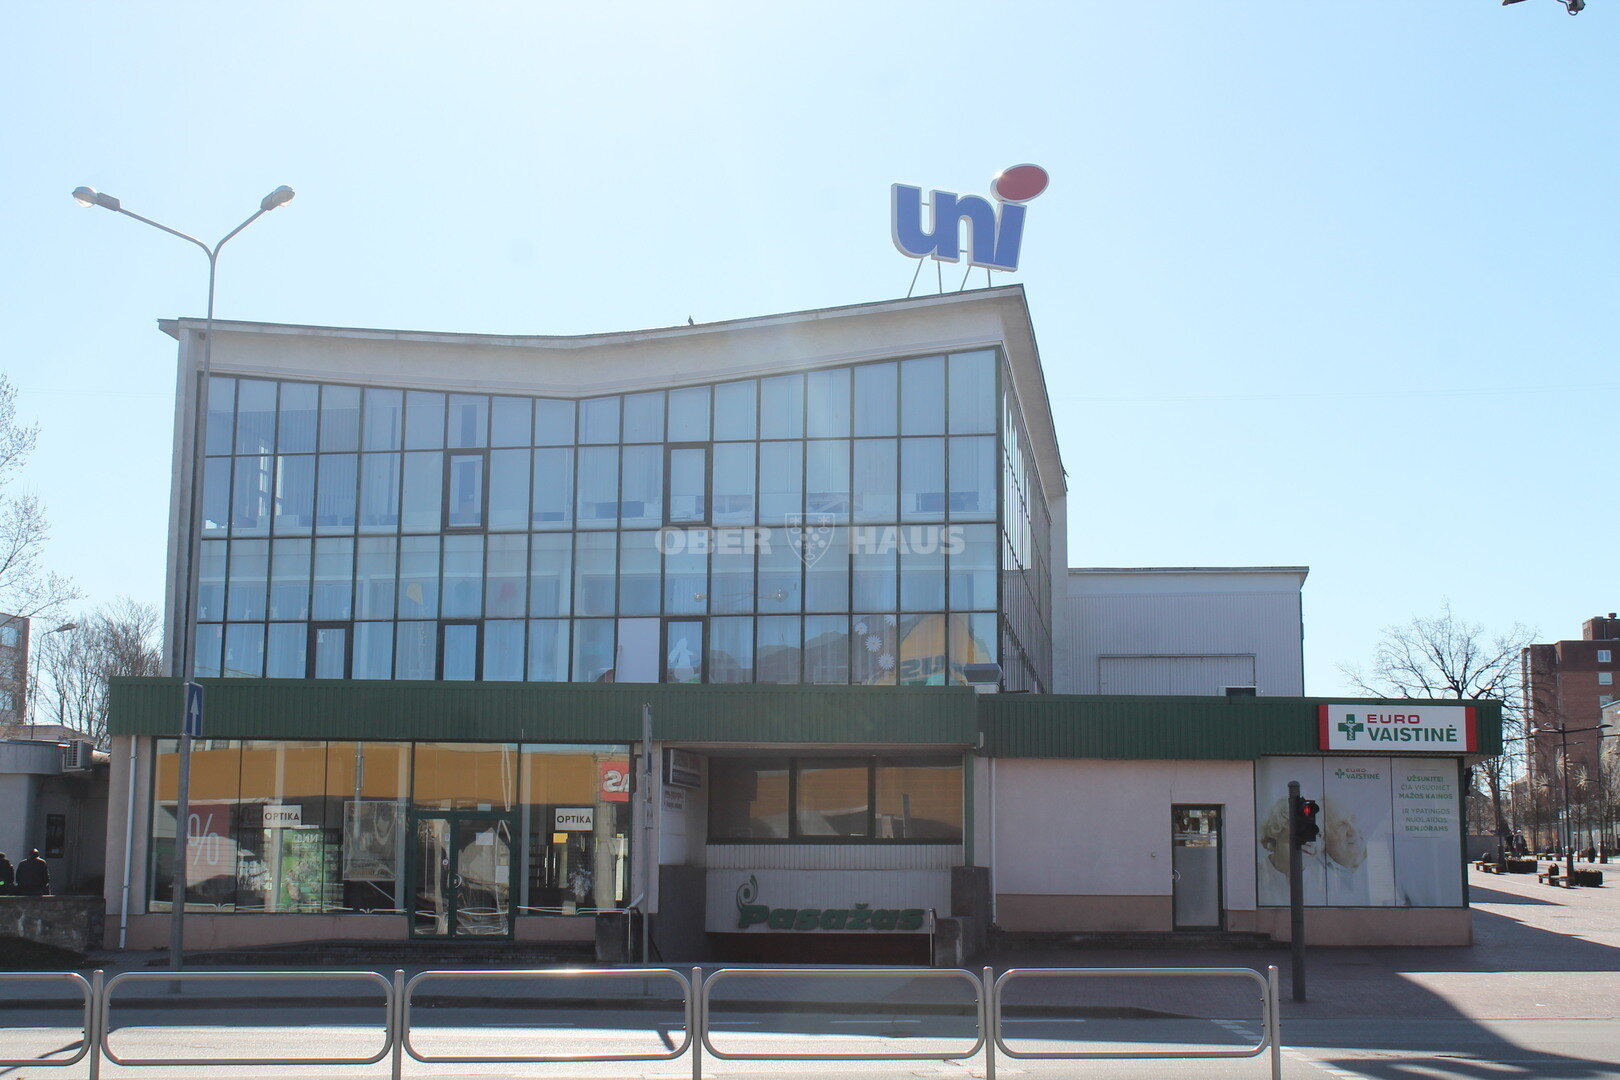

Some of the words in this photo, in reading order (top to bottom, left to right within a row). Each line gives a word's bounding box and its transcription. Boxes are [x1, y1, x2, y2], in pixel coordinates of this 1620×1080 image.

[891, 163, 1050, 272] uni
[1367, 714, 1421, 724] EURO
[1367, 724, 1458, 742] VAISTINĖ
[264, 811, 300, 821] OPTIKA
[1411, 807, 1451, 815] YPATINGOS
[556, 815, 592, 824] OPTIKA
[1405, 816, 1448, 824] NUOLAIDOS
[738, 903, 925, 930] Pasažas
